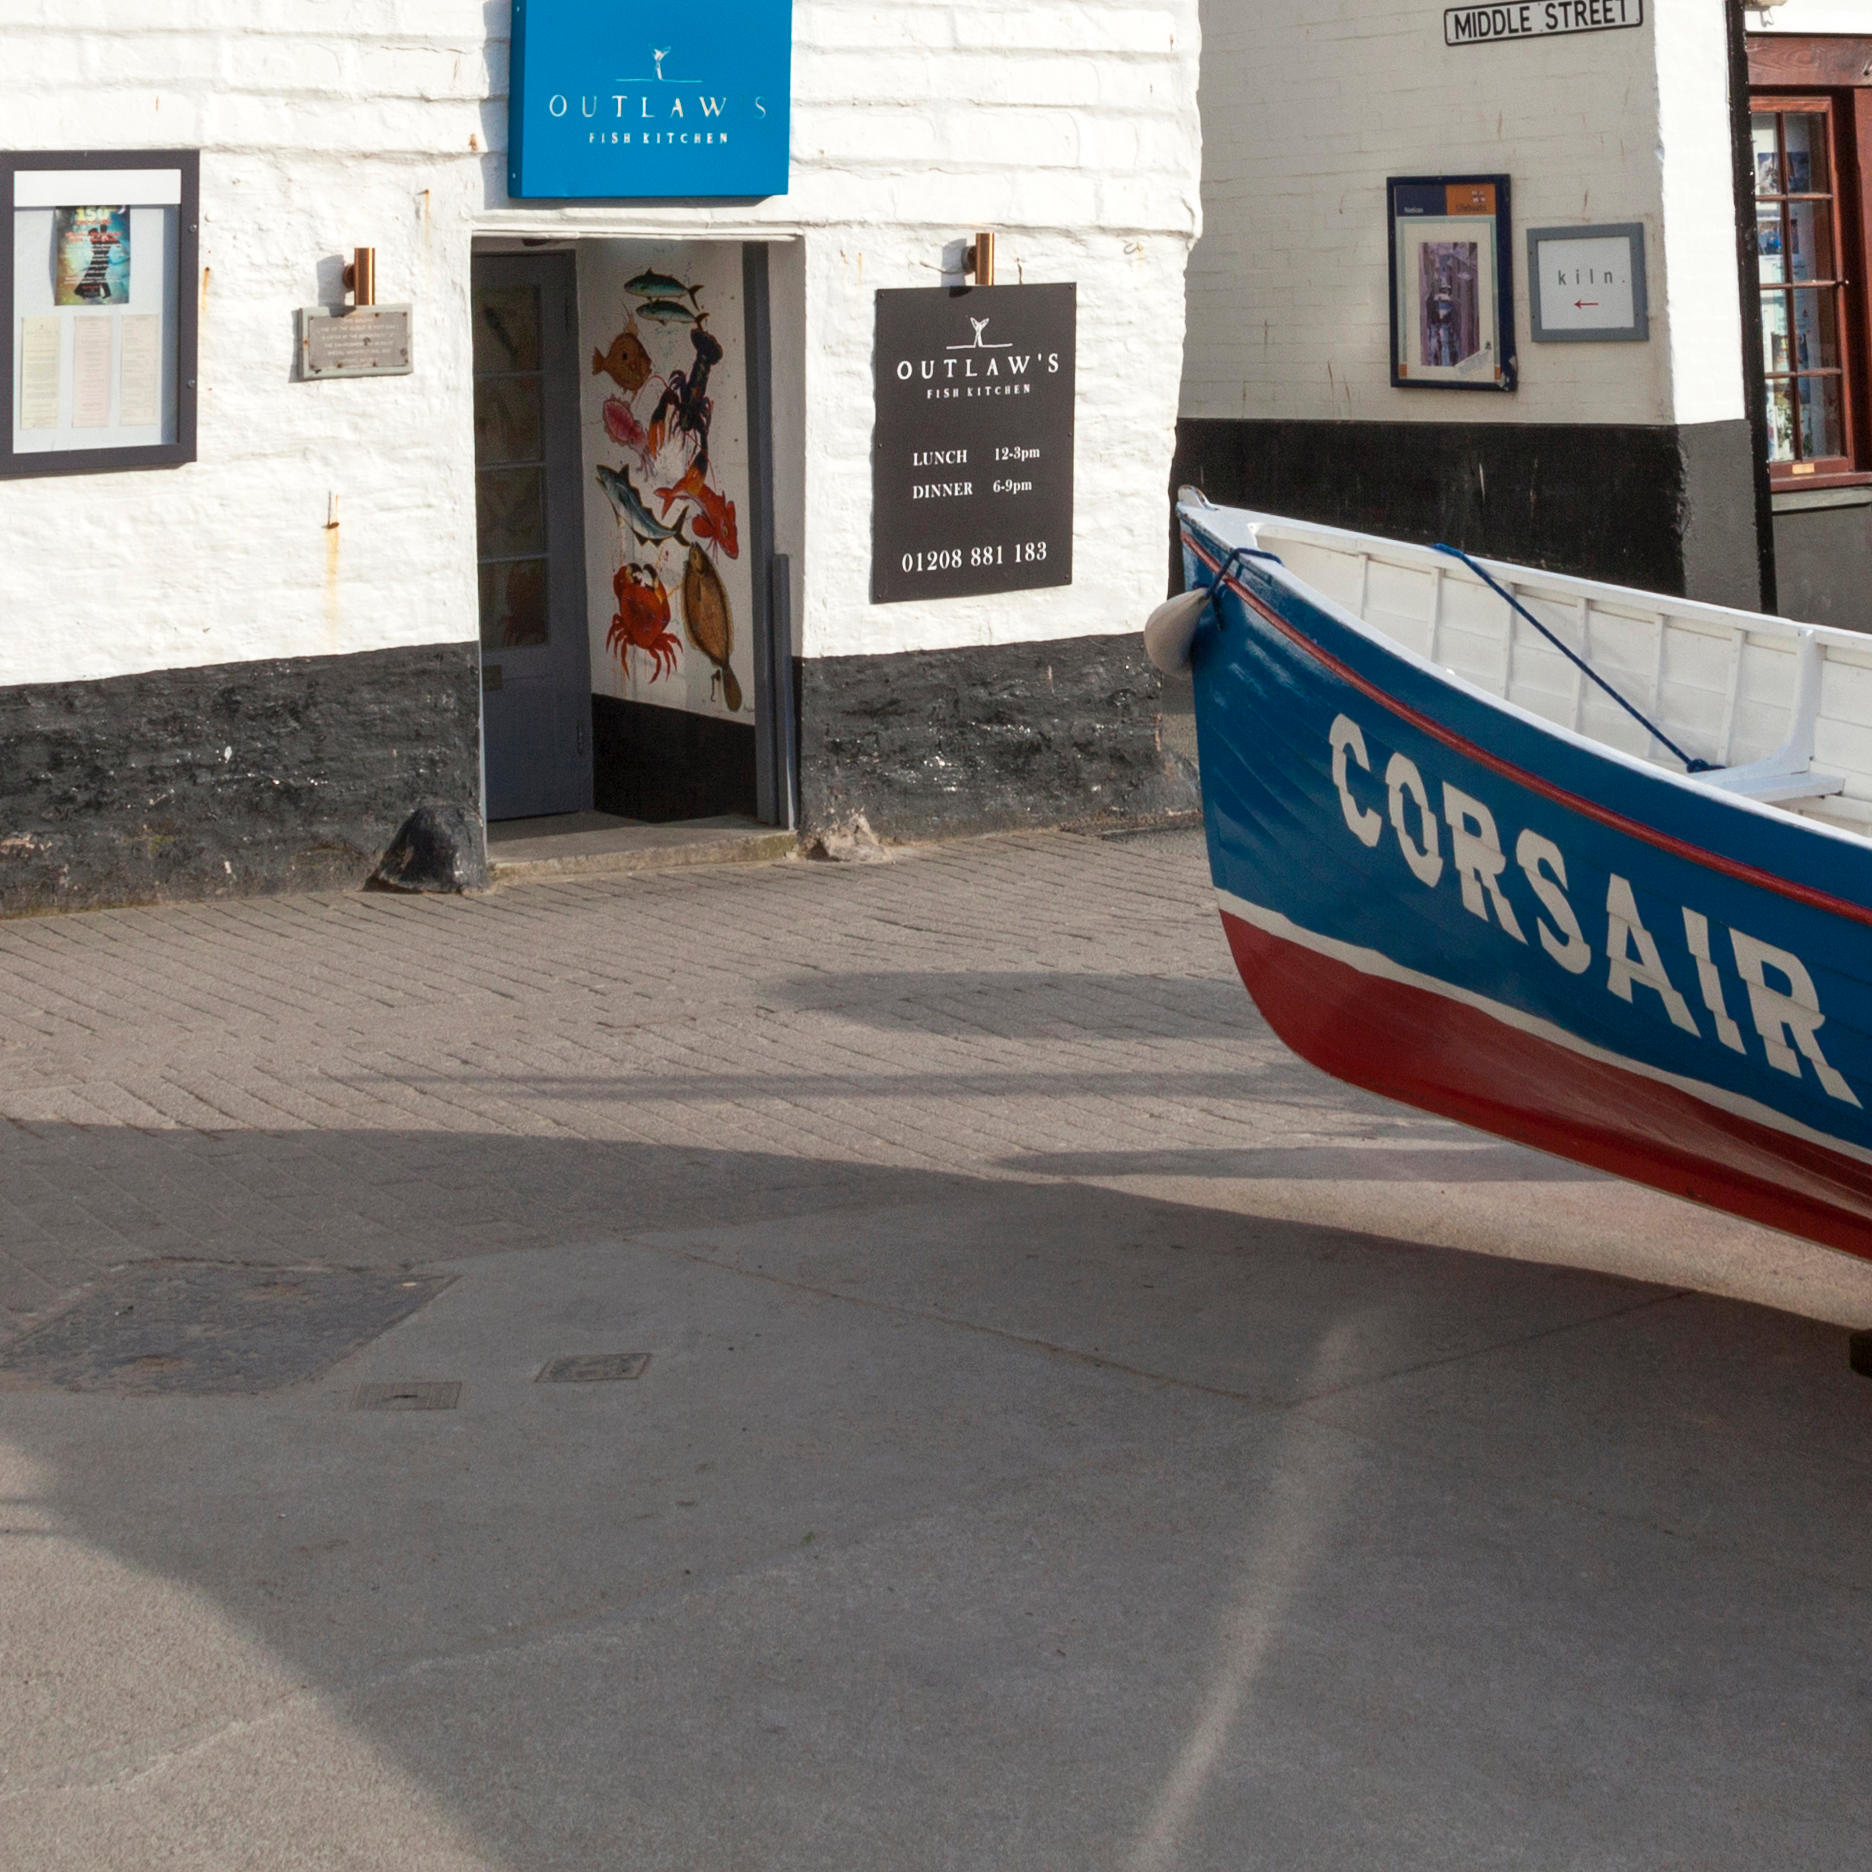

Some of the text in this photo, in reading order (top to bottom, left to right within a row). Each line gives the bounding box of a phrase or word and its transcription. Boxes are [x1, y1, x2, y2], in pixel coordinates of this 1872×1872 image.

[1454, 6, 1532, 40] MIDDLE
[549, 94, 767, 119] OUTLAWS
[588, 132, 728, 144] FISH KITCHEN
[1558, 268, 1626, 285] kiln.
[896, 353, 1059, 380] OUTLAW'S
[927, 383, 1031, 399] FISH KITCHEN
[913, 447, 1040, 466] LUNCH 12-3pm
[913, 479, 1032, 499] DINNER 6-9pm
[902, 541, 1047, 573] 01208 881 183
[1328, 713, 1864, 1110] CORSAIR
